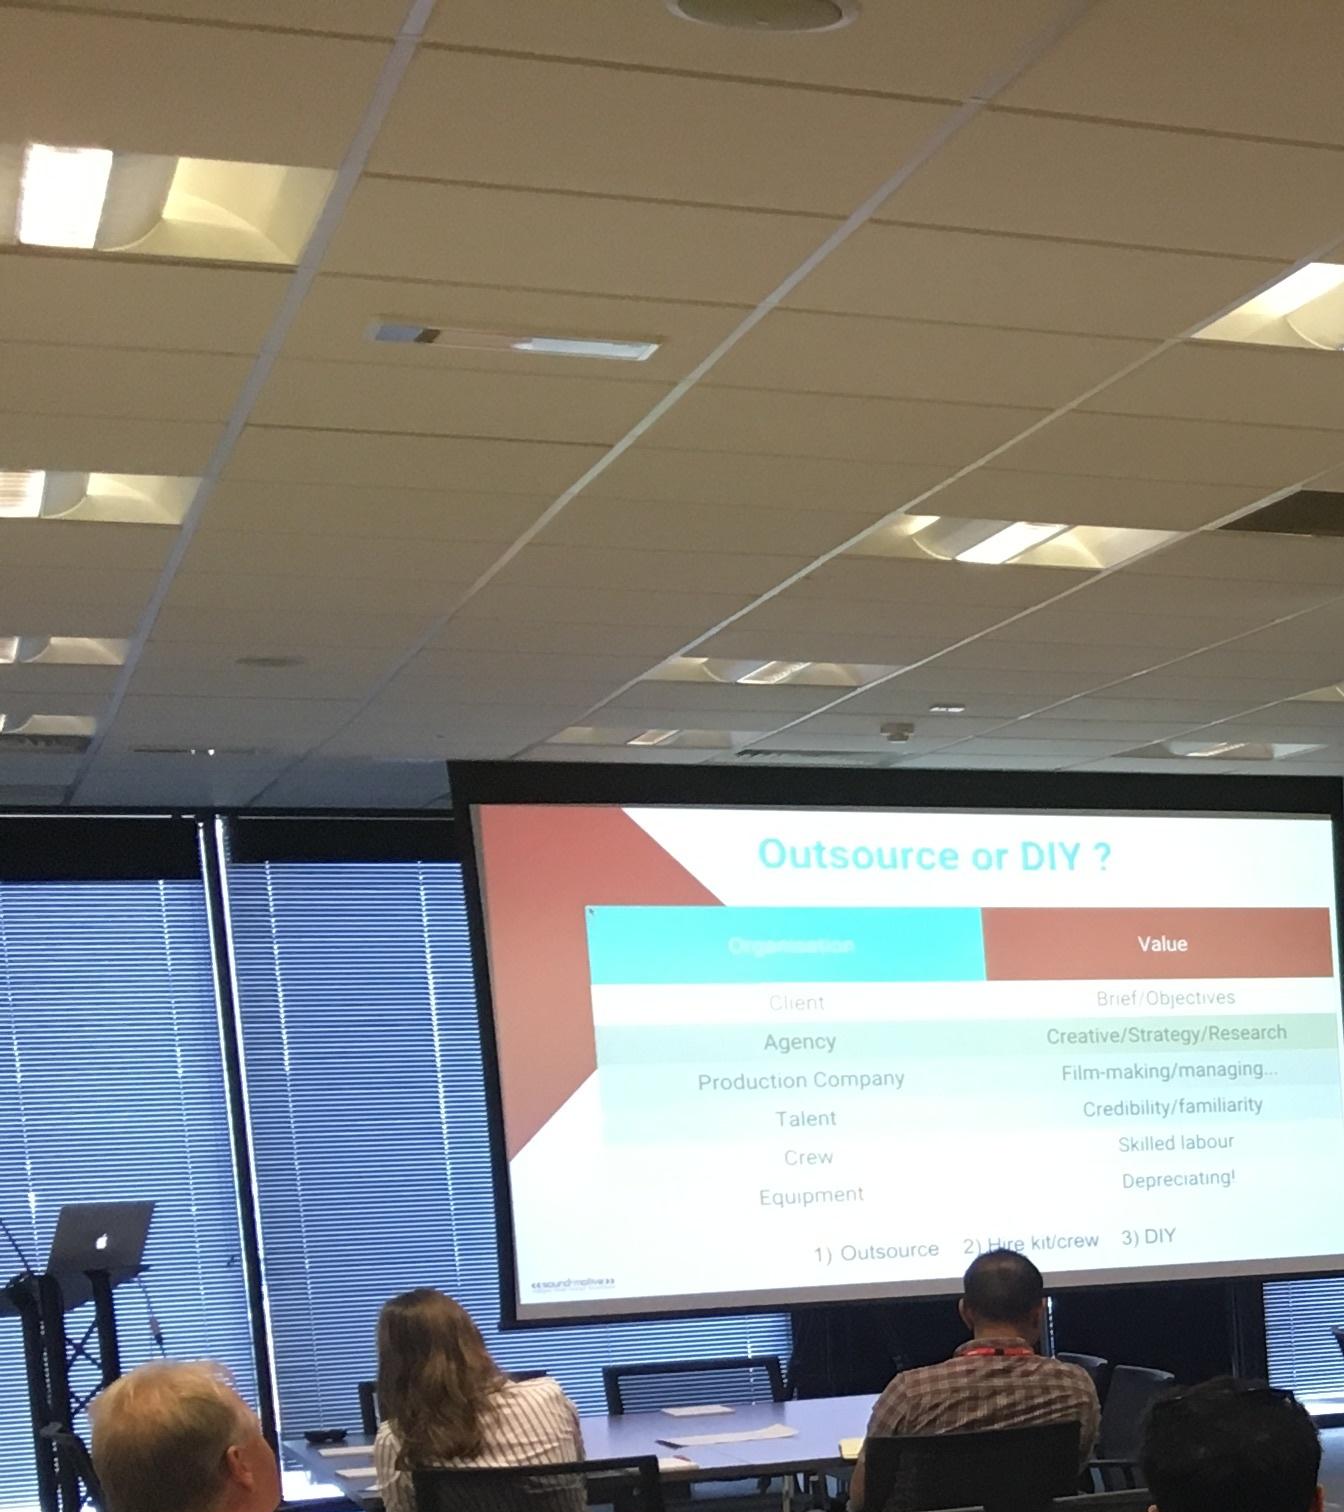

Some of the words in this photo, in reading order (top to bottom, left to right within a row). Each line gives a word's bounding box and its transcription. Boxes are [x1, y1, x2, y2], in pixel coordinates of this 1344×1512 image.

[758, 837, 960, 871] Outsource
[971, 846, 1008, 871] or
[1020, 841, 1081, 872] DIY
[1093, 842, 1112, 871] ?
[728, 936, 854, 958] Orgation
[1137, 935, 1189, 952] Value
[769, 994, 825, 1012] Client
[1096, 989, 1236, 1010] Brief/Objectives
[763, 1033, 837, 1054] Agency
[1046, 1024, 1288, 1046] Creative/Strategy/Research
[698, 1073, 808, 1091] Production
[813, 1071, 905, 1091] Company
[1061, 1061, 1279, 1082] Film-making/managing...
[1083, 1096, 1264, 1119] Credibility/familiarity
[775, 1110, 838, 1128] Talent
[1118, 1135, 1176, 1153] Skilled
[1180, 1134, 1235, 1151] labour
[784, 1149, 834, 1166] Crew
[1122, 1169, 1236, 1191] Depreciating!
[759, 1185, 865, 1208] Equipment
[814, 1246, 834, 1267] 1)
[840, 1243, 940, 1262] Outsource
[962, 1238, 982, 1256] 2)
[987, 1237, 1026, 1253] Hire
[1031, 1234, 1100, 1250] kit/crew
[1121, 1230, 1140, 1248] 3)
[1144, 1228, 1177, 1245] DIY
